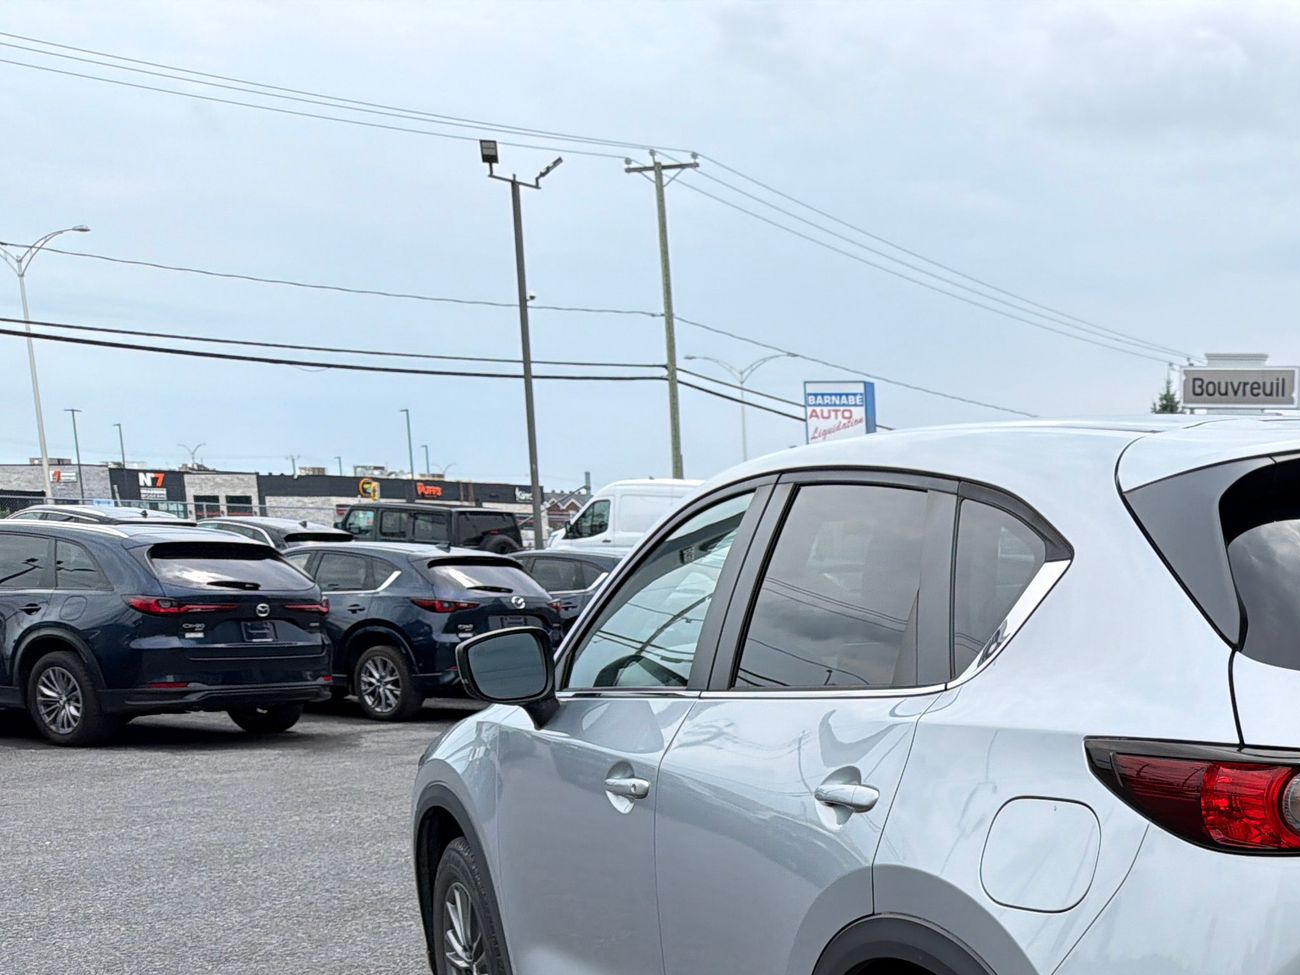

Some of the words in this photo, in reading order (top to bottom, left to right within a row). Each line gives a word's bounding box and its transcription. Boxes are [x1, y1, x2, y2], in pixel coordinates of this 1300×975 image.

[1191, 377, 1285, 398] Bouvreuil
[808, 394, 863, 405] BARNABÉ
[808, 409, 853, 420] AUTO
[810, 417, 864, 440] Liquidation
